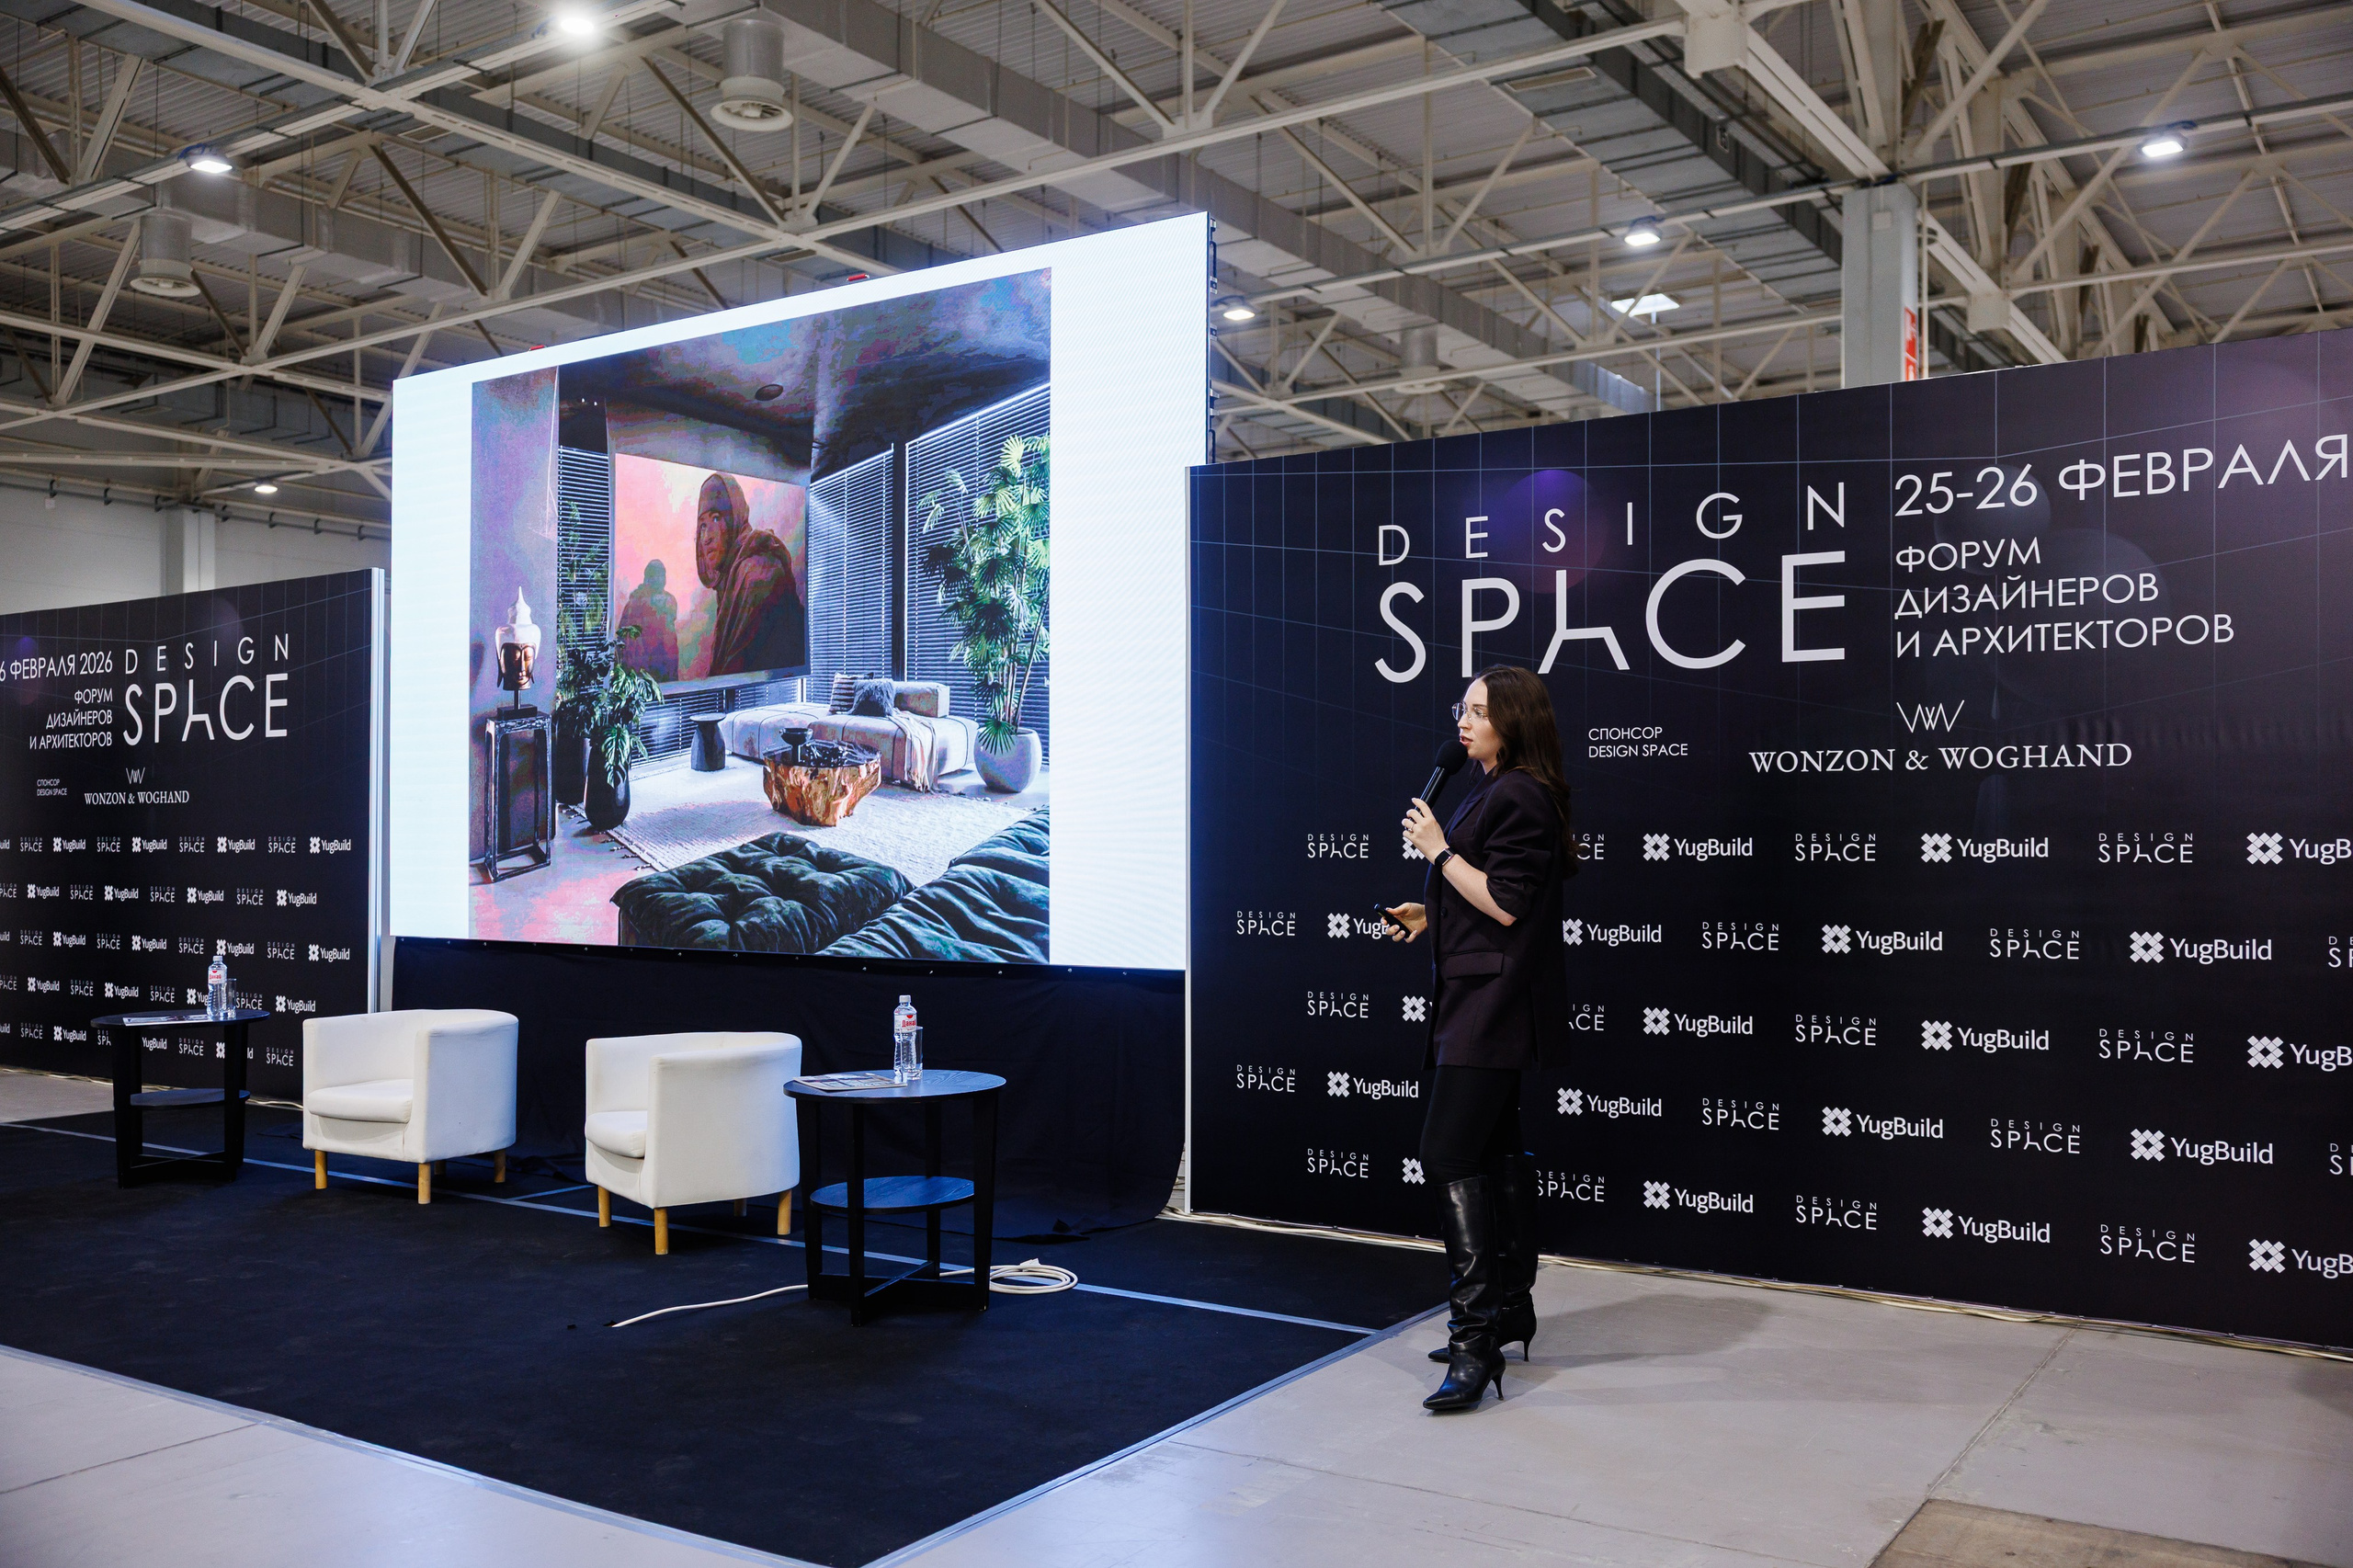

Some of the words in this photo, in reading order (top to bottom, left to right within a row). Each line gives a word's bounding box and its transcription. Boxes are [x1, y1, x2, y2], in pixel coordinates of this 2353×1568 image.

[1895, 464, 2037, 516] 25-26
[2059, 434, 2347, 500] ФЕВРАЛЯ
[1379, 483, 1845, 569] DESIGN
[1896, 537, 2040, 573] ФОРУМ
[1895, 574, 2161, 623] ДИЗАЙНЕРОВ
[1375, 547, 1845, 683] SPACE
[1897, 631, 1919, 658] И
[1933, 614, 2234, 656] АРХИТЕКТОРОВ
[126, 633, 288, 674] DESIGN
[10, 654, 74, 679] ФЕВРАЛЯ
[80, 651, 112, 675] 2026
[74, 688, 112, 704] ФОРУМ
[123, 673, 288, 745] SPACE
[46, 709, 112, 729] ДИЗАЙНЕРОВ
[29, 736, 37, 749] И
[39, 732, 112, 749] АРХИТЕКТОРОВ
[1588, 727, 1662, 740] СПОНСОР
[1589, 745, 1638, 757] DESIGN
[1643, 744, 1688, 756] SPACE
[1749, 749, 1895, 772] WONZON
[1905, 750, 1928, 770] &
[1938, 744, 2131, 768] WOGHAND
[85, 792, 126, 804] WONZON
[128, 793, 134, 804] &
[138, 790, 189, 803] WOGHAND
[142, 839, 167, 853] YugBuild
[228, 839, 255, 853] YugBuild
[322, 839, 351, 854] YugBuild
[2099, 833, 2192, 841] DESIGN
[1308, 843, 1369, 858] SPACE
[1674, 837, 1752, 861] YugBuild
[1795, 844, 1875, 861] SPACE
[1957, 837, 2048, 863] YugBuild
[2098, 844, 2192, 863] SPACE
[2290, 839, 2351, 865] YugB
[198, 891, 223, 903] YugBuild
[288, 892, 316, 907] YugBuild
[1237, 911, 1295, 919] DESIGN
[1237, 919, 1295, 936] SPACE
[1587, 924, 1661, 947] YugBuild
[1702, 922, 1779, 931] DESIGN
[1990, 928, 2079, 938] DESIGN
[142, 938, 166, 951] YugBuild
[227, 943, 254, 957] YugBuild
[1702, 932, 1779, 950] SPACE
[1856, 931, 1942, 955] YugBuild
[1990, 939, 2079, 959] SPACE
[320, 948, 349, 962] YugBuild
[2170, 938, 2271, 964] YugBuild
[1308, 991, 1369, 1000] DESIGN
[287, 999, 315, 1014] YugBuild
[1308, 1000, 1369, 1017] SPACE
[1675, 1014, 1753, 1037] YugBuild
[1796, 1015, 1876, 1026] DESIGN
[97, 1035, 111, 1045] SPA
[1795, 1025, 1876, 1046] SPACE
[1958, 1028, 2049, 1052] YugBuild
[2099, 1028, 2193, 1040] DESIGN
[2099, 1040, 2193, 1062] SPACE
[2290, 1044, 2352, 1072] YugB
[1237, 1064, 1295, 1074] DESIGN
[1237, 1074, 1295, 1092] SPACE
[1353, 1078, 1418, 1099] YugBuild
[1587, 1095, 1662, 1119] YugBuild
[1703, 1098, 1779, 1110] DESIGN
[1702, 1108, 1779, 1130] SPACE
[1857, 1115, 1943, 1140] YugBuild
[1991, 1119, 2079, 1132] DESIGN
[1991, 1130, 2079, 1153] SPACE
[1308, 1149, 1369, 1160] DESIGN
[2171, 1138, 2273, 1165] YugBuild
[1308, 1157, 1368, 1178] SPACE
[1675, 1188, 1753, 1213] YugBuild
[1797, 1195, 1876, 1210] DESIGN
[1796, 1205, 1876, 1230] SPACE
[1959, 1216, 2050, 1243] YugBuild
[2101, 1224, 2194, 1241] DESIGN
[2100, 1235, 2194, 1263] SPACE
[2291, 1249, 2353, 1278] YugB
